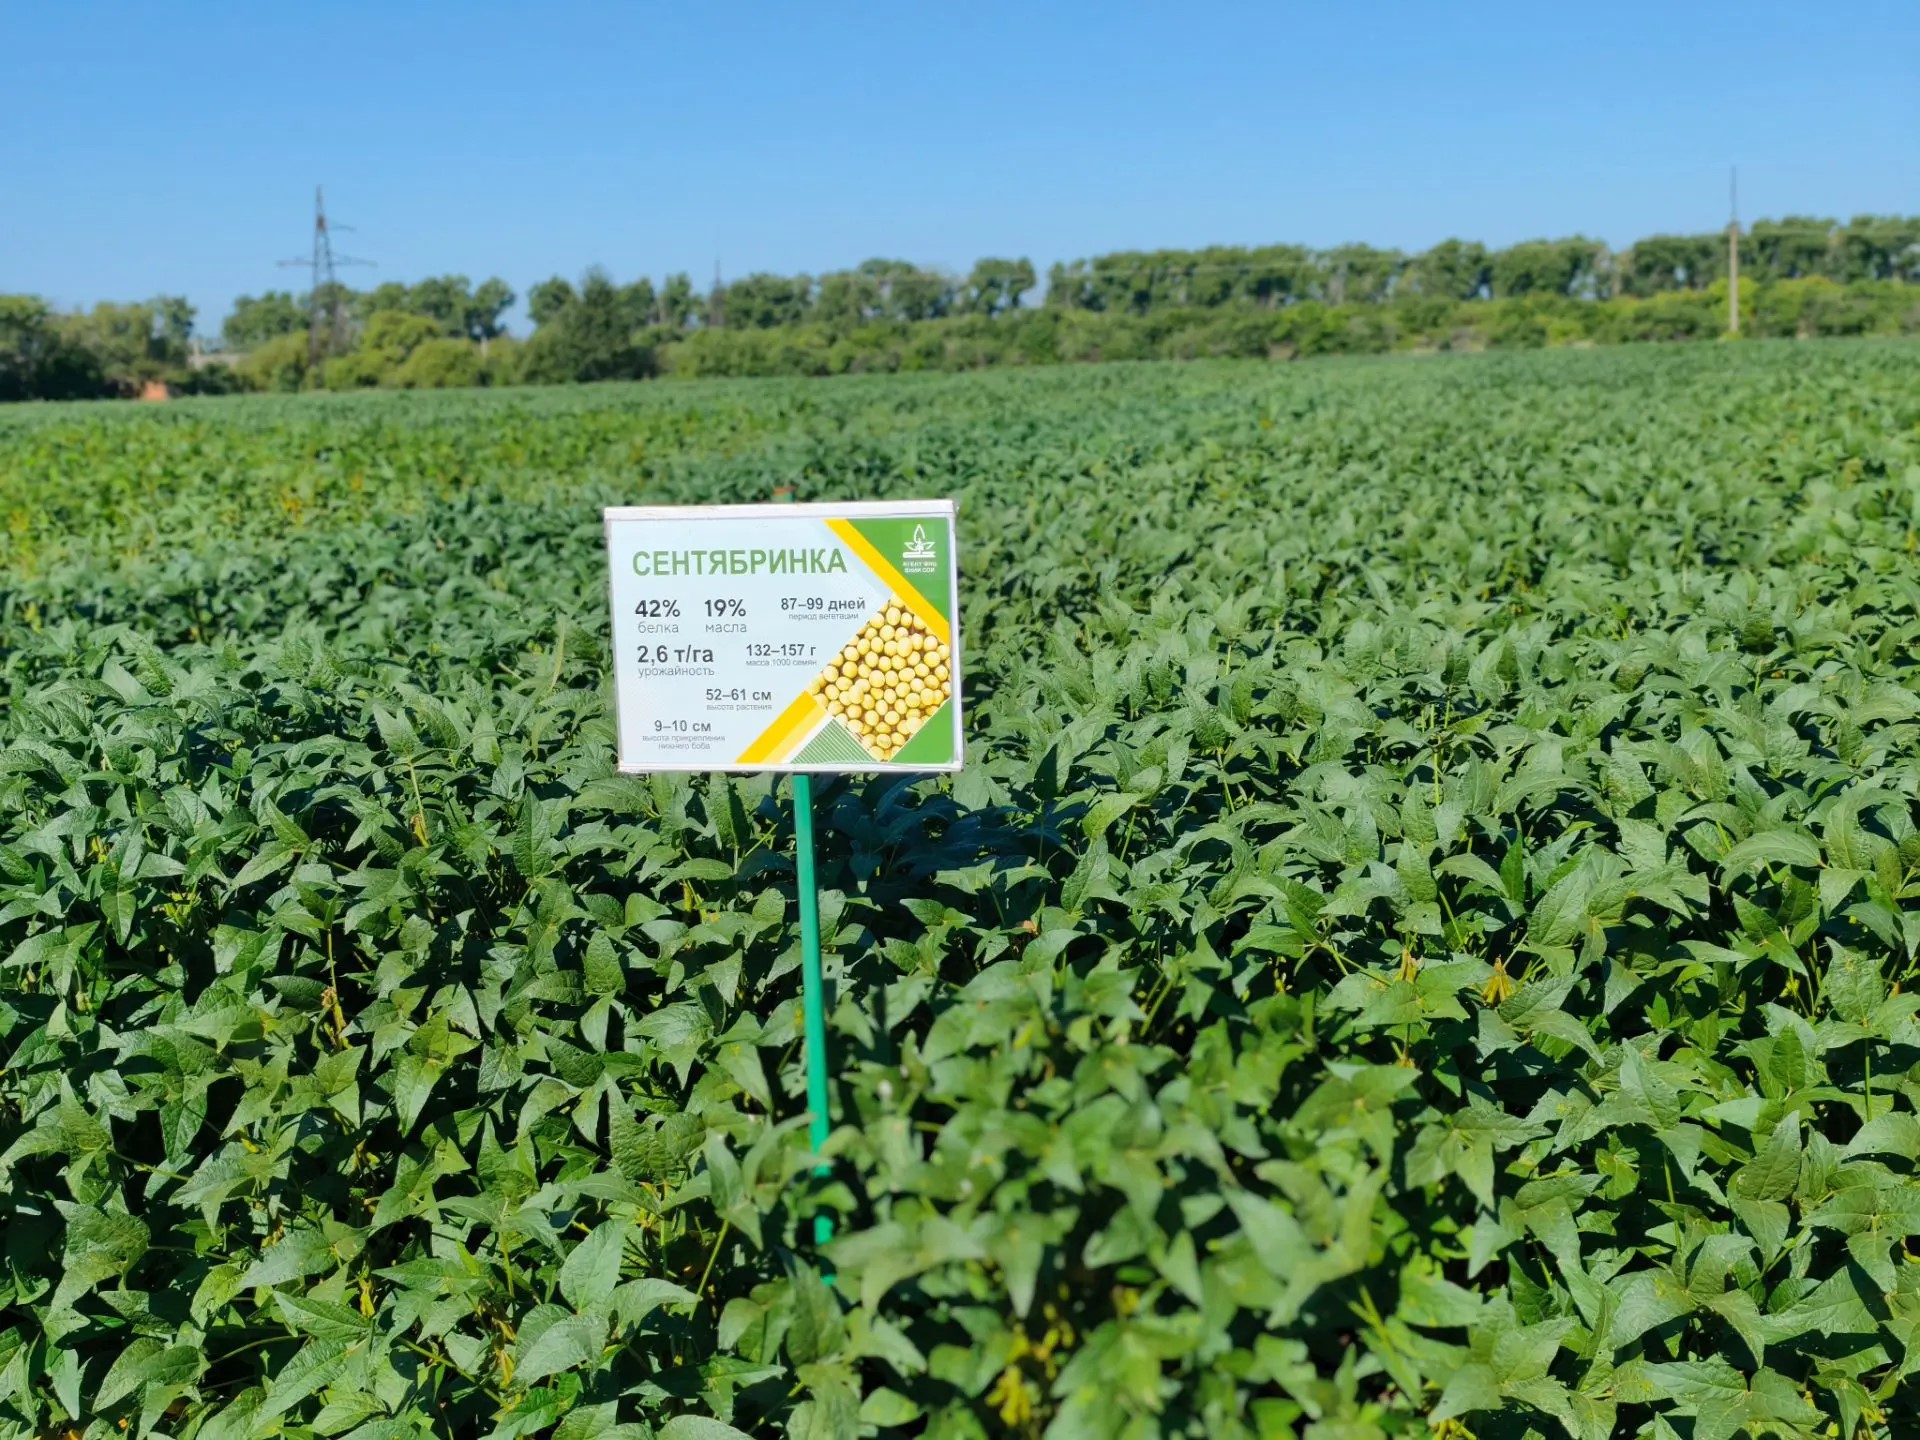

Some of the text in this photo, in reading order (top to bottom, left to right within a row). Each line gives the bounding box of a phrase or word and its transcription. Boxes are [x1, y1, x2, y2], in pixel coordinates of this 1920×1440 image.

[632, 548, 847, 576] СЕНТЯБРИНКА
[635, 599, 681, 618] 42%
[704, 598, 746, 617] 19%
[828, 597, 866, 612] дней
[789, 612, 859, 621] период вегетации
[638, 621, 679, 634] белка
[705, 622, 747, 633] масла
[637, 644, 714, 666] 2,6 т/га
[810, 645, 817, 656] г
[772, 658, 791, 666] 1000
[638, 665, 715, 678] урожайность
[752, 690, 772, 701] см
[736, 703, 772, 712] растения
[693, 722, 711, 732] см
[671, 734, 725, 743] прикрепления
